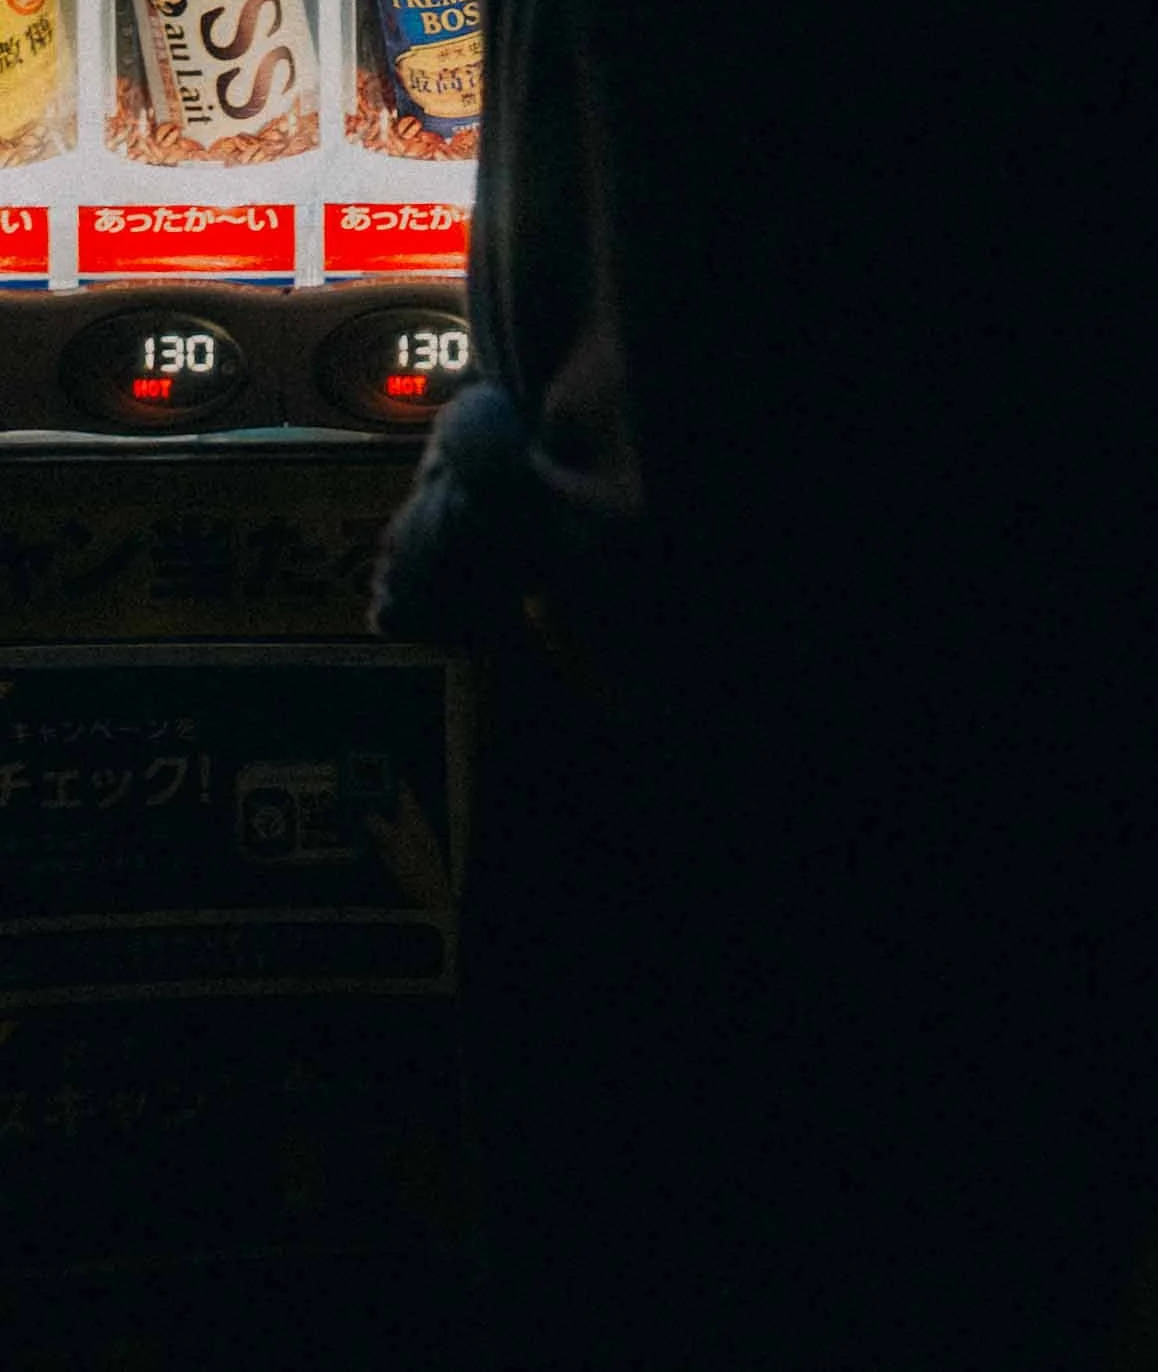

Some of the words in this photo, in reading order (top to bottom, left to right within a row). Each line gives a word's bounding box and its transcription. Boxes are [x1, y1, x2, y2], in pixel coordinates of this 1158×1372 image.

[165, 22, 192, 63] au
[175, 67, 217, 127] Lait
[143, 333, 216, 374] 130
[398, 331, 469, 371] 130
[132, 378, 175, 402] HOT
[385, 374, 428, 398] HOT
